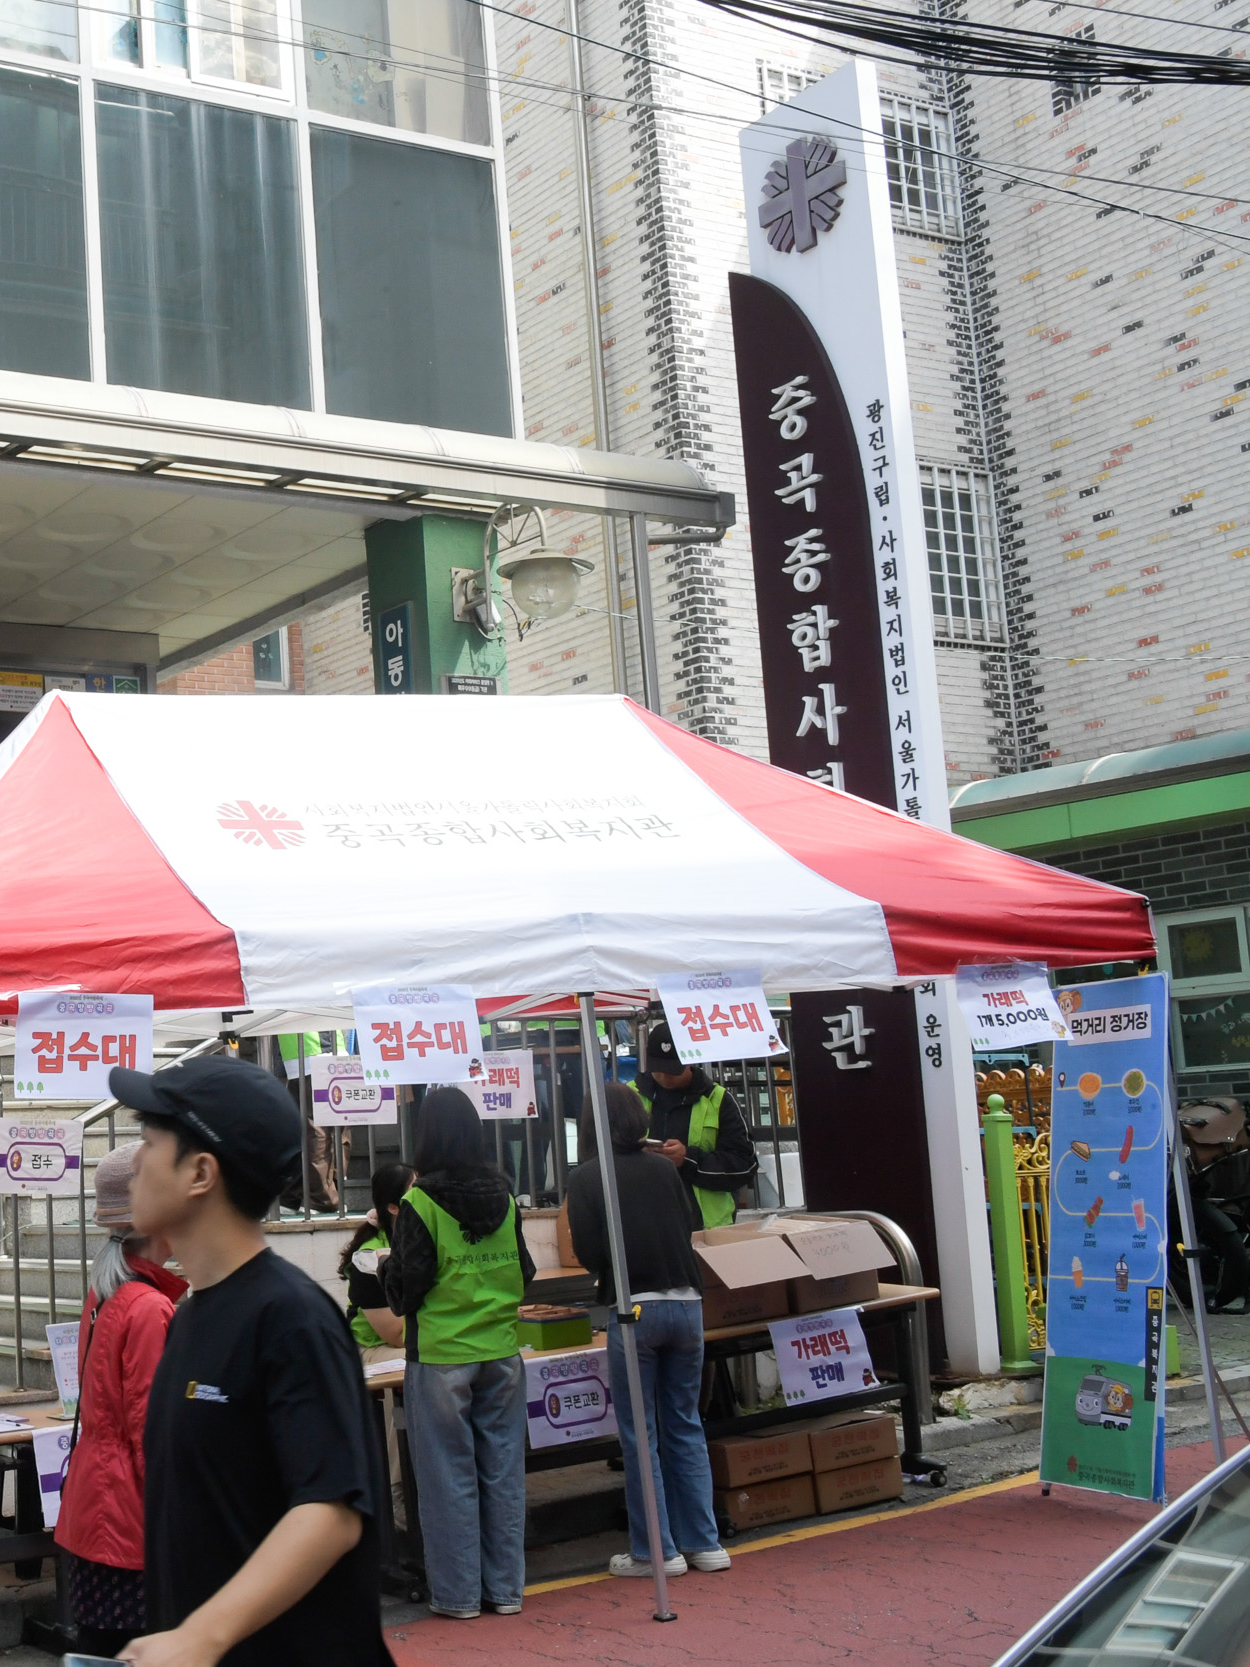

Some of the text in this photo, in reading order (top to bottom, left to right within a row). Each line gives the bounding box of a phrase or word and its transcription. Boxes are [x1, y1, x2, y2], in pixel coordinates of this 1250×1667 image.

[384, 620, 405, 693] 아동
[895, 710, 923, 820] 서울가톨
[322, 813, 682, 850] 중곡종합사회복지관
[982, 989, 1029, 1008] 가래떡
[676, 1002, 765, 1042] 접수대
[997, 1007, 1050, 1028] 5,000원
[1070, 1011, 1149, 1036] 먹거리 정거장
[31, 1031, 137, 1074] 접수대
[371, 1021, 468, 1062] 접수대
[923, 1013, 943, 1068] 운영
[345, 1088, 376, 1101] 쿠폰교환
[482, 1091, 512, 1112] 판매
[31, 1154, 53, 1170] 접수
[791, 1329, 851, 1360] 가래떡
[809, 1361, 845, 1390] 판매
[563, 1391, 600, 1410] 쿠폰교환
